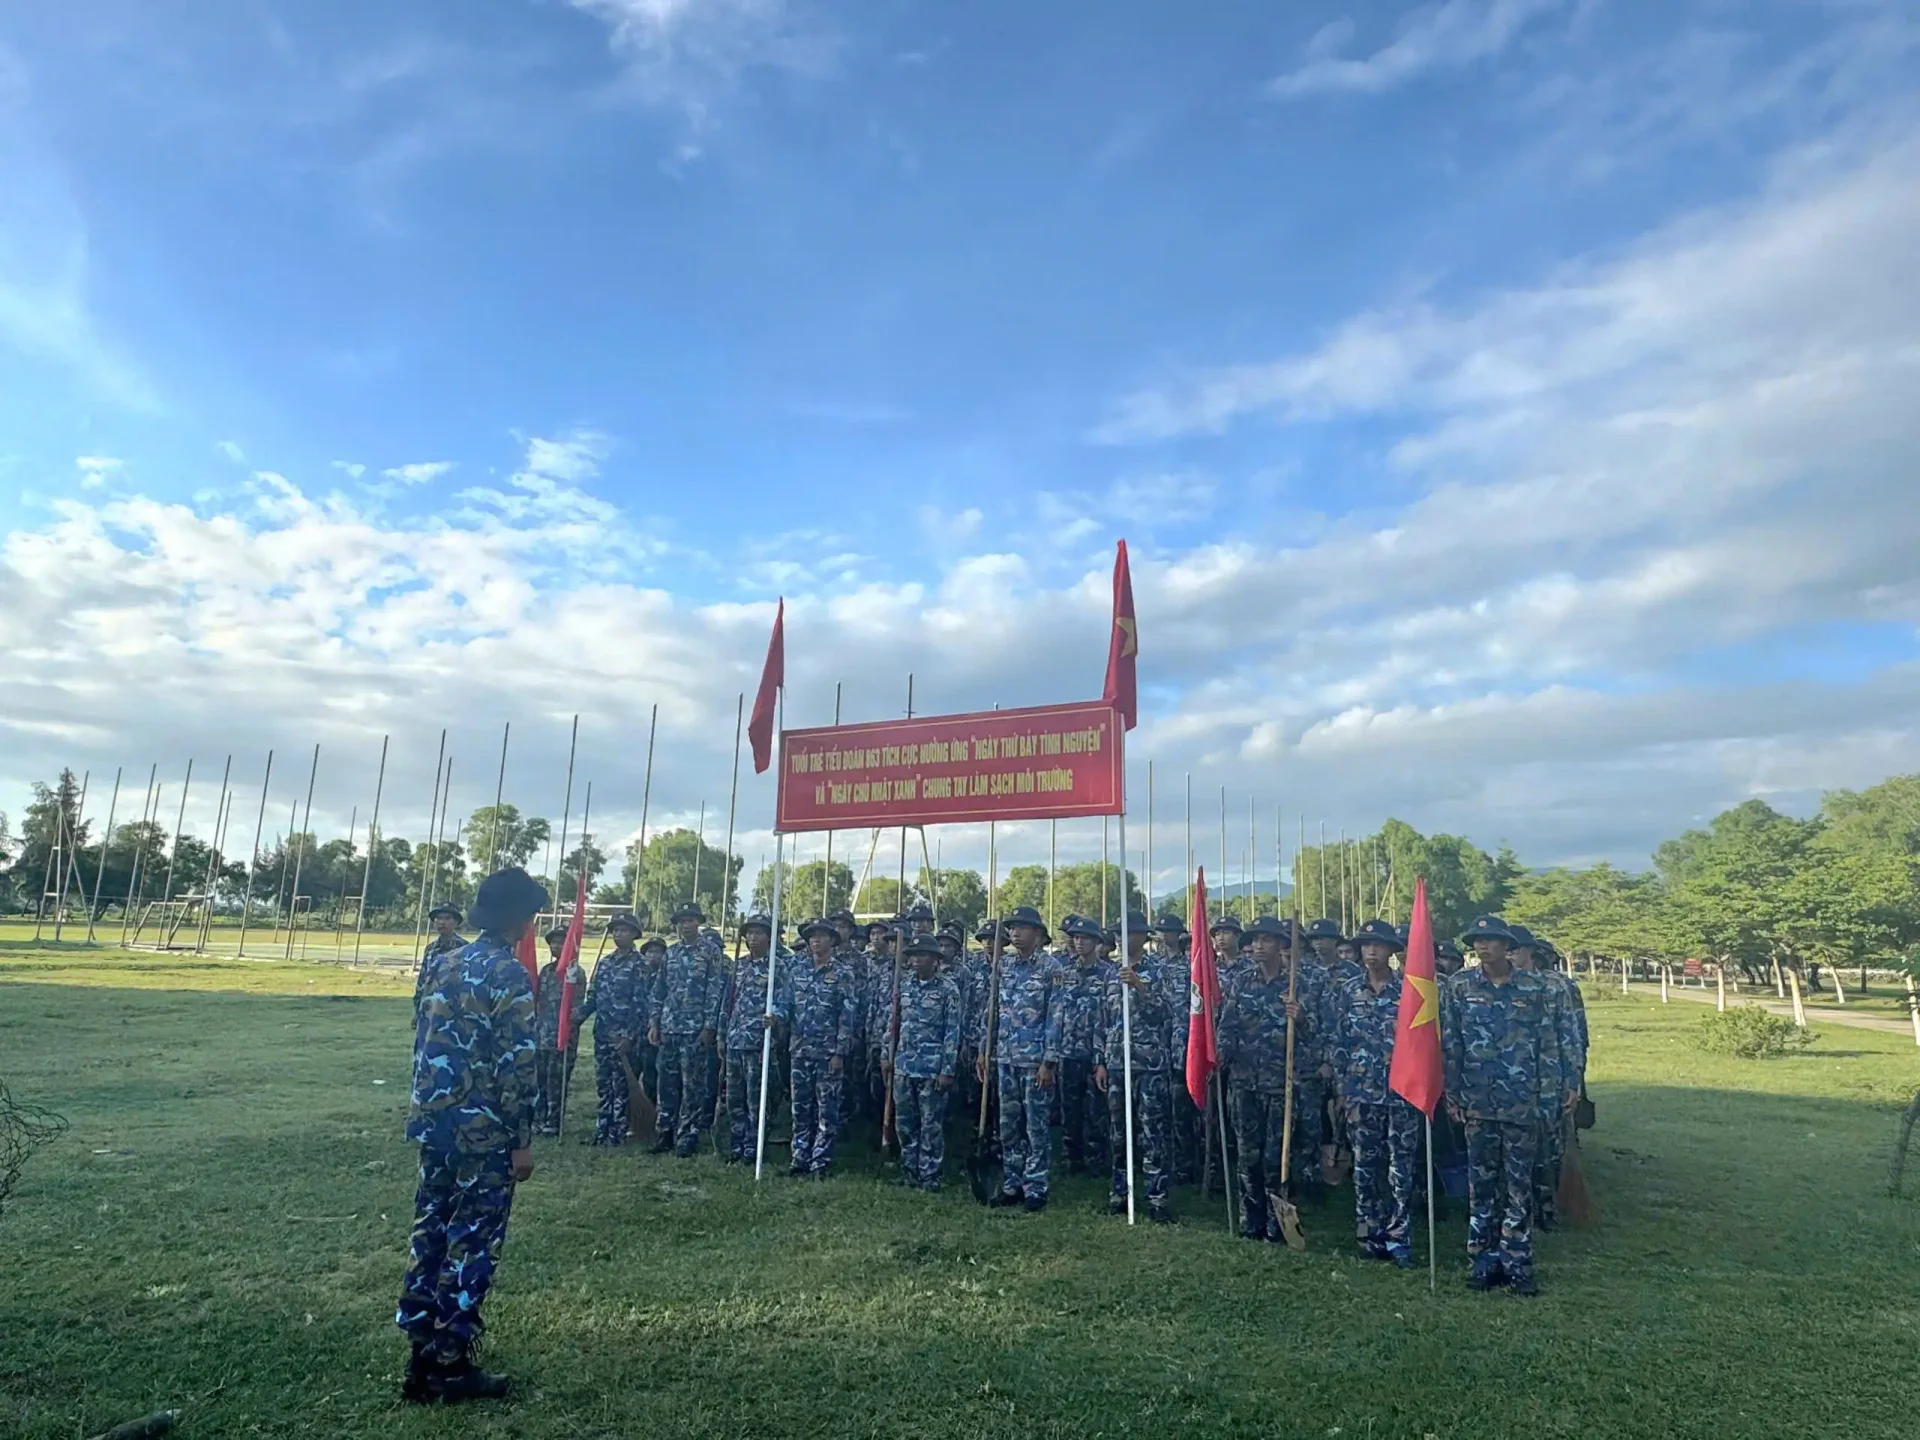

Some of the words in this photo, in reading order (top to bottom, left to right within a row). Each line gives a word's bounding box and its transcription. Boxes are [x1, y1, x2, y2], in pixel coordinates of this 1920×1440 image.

[882, 742, 900, 767] TÍCH
[901, 743, 918, 769] CỰC
[920, 736, 949, 763] HƯỞNG
[950, 737, 969, 762] ỨNG
[1000, 732, 1019, 759] THỨ
[1019, 728, 1038, 757] BẢY
[1039, 729, 1061, 755] TÌNH
[853, 775, 870, 803] CHỦ
[871, 776, 892, 806] NHẬT
[922, 777, 952, 799] CHUNG
[953, 775, 968, 797] TAY
[969, 771, 988, 797] LÀM
[990, 772, 1015, 800] SẠCH
[1016, 767, 1035, 793] MÔI
[1036, 764, 1074, 792] TRƯỜNG
